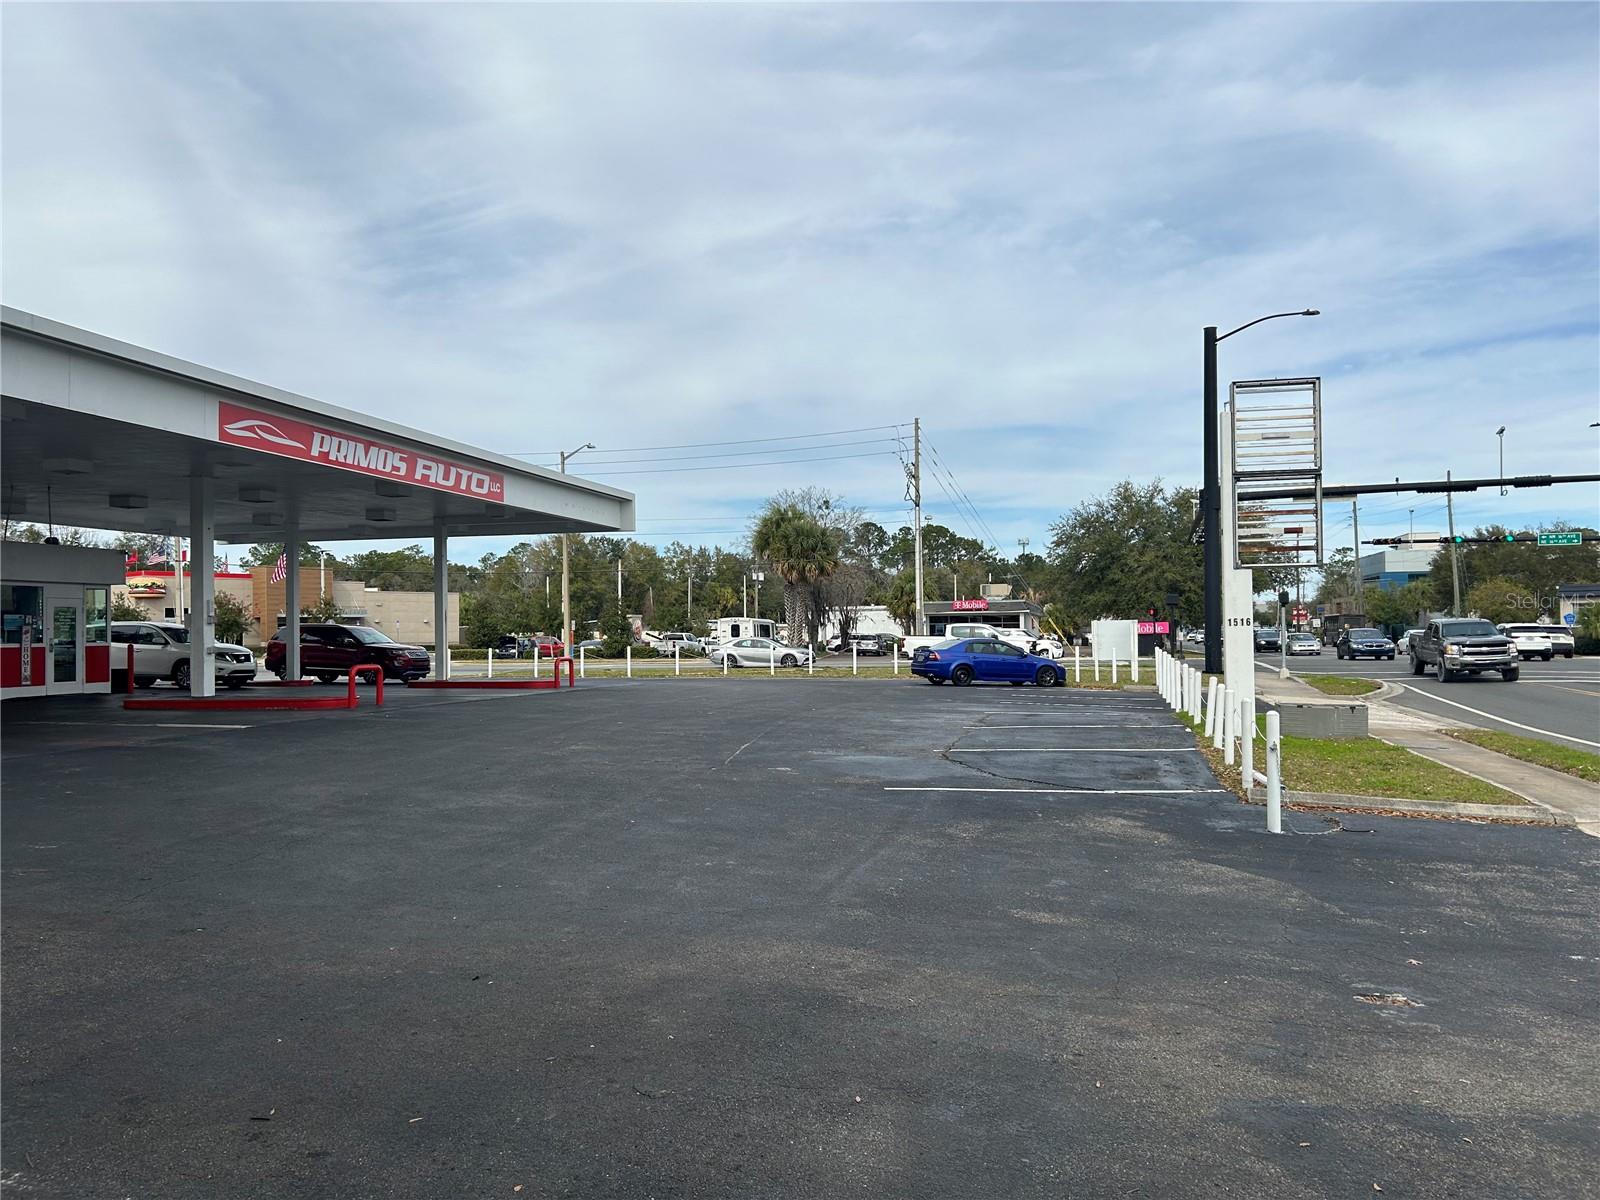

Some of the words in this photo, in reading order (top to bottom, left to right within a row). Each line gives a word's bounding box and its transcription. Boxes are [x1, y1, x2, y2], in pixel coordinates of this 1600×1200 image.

[310, 431, 408, 476] PRIMOS
[414, 458, 491, 495] AUTO
[490, 481, 501, 493] LLC
[1228, 617, 1251, 627] 1516
